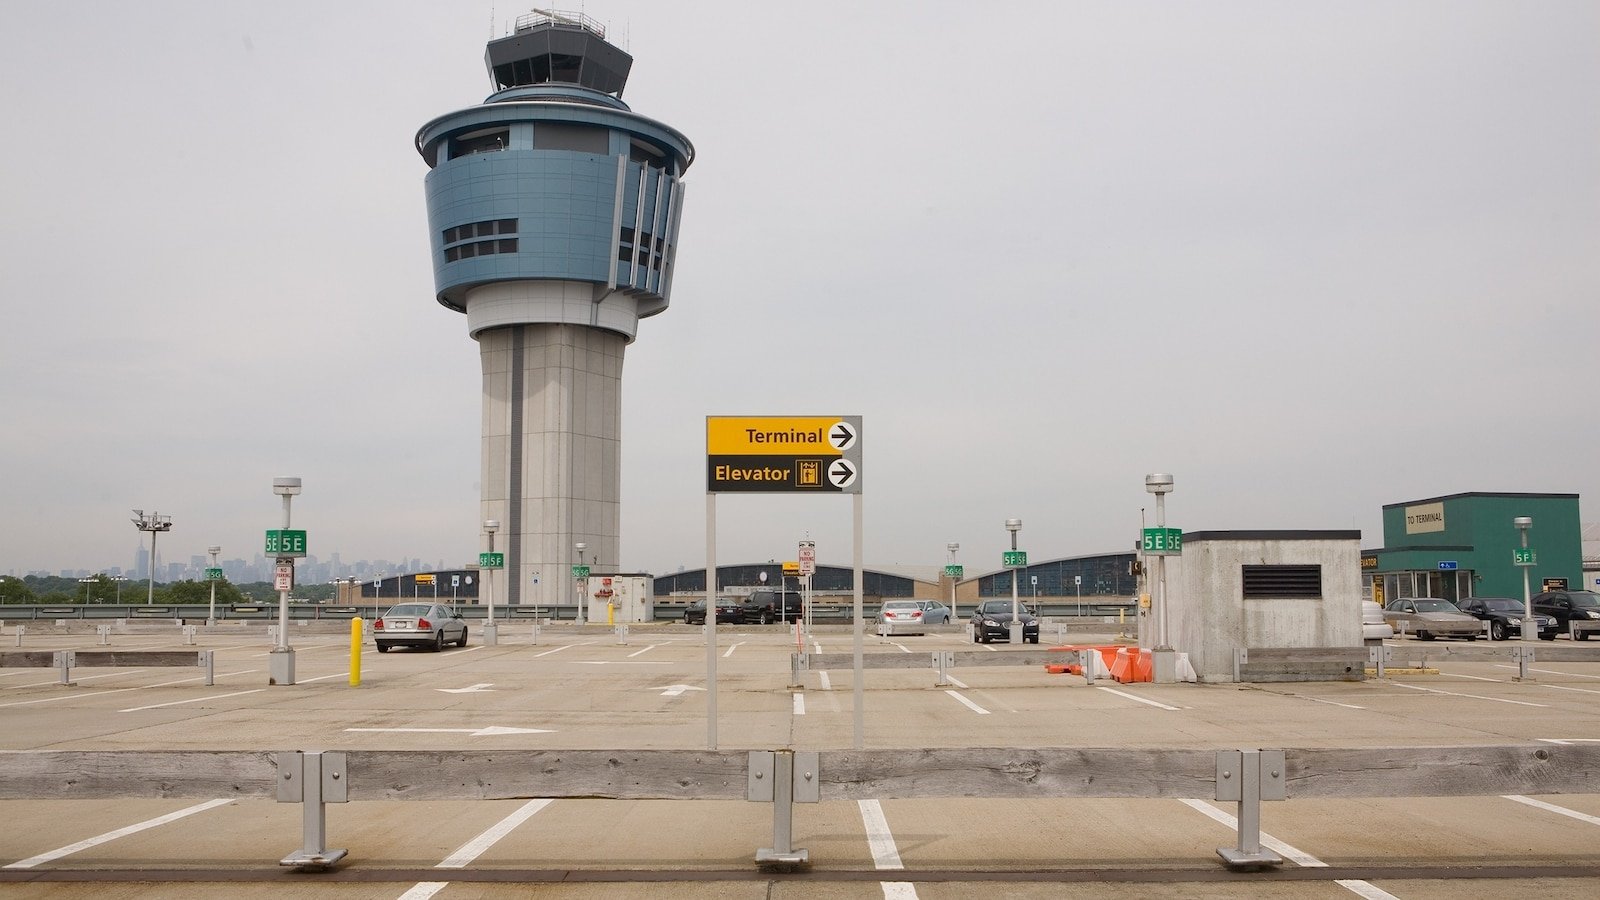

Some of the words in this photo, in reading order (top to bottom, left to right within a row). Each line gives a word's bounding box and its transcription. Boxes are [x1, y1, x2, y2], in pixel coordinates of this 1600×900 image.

[745, 428, 823, 443] Terminal
[715, 465, 791, 481] Elevator
[1407, 516, 1415, 525] TO
[1416, 513, 1442, 524] TERMINAL
[266, 537, 277, 551] 5E
[282, 537, 302, 551] 5E
[1145, 535, 1164, 549] 5E
[1168, 535, 1180, 549] 5E
[490, 557, 501, 566] 5F
[1005, 556, 1016, 565] 5F
[1516, 553, 1530, 562] 5F
